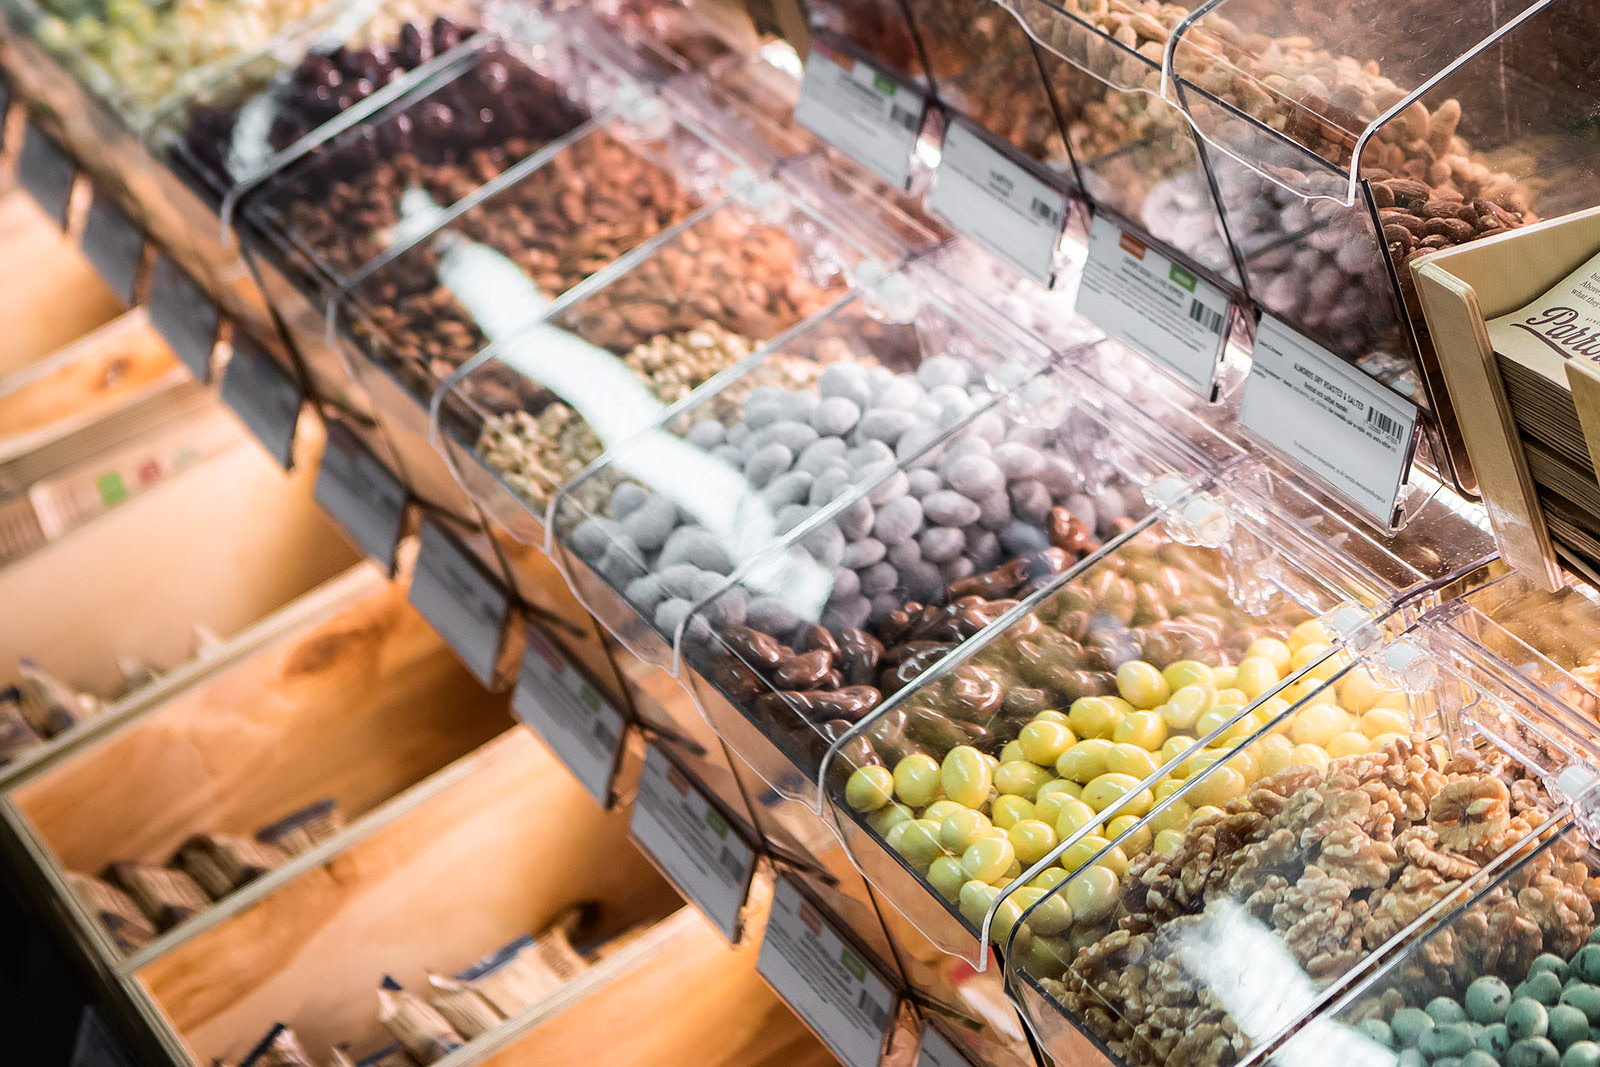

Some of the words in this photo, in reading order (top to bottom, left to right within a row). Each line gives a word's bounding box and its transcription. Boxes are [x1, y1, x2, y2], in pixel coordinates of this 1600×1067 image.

[1571, 288, 1588, 300] what
[1579, 281, 1600, 294] Above
[1347, 395, 1364, 411] SALTED
